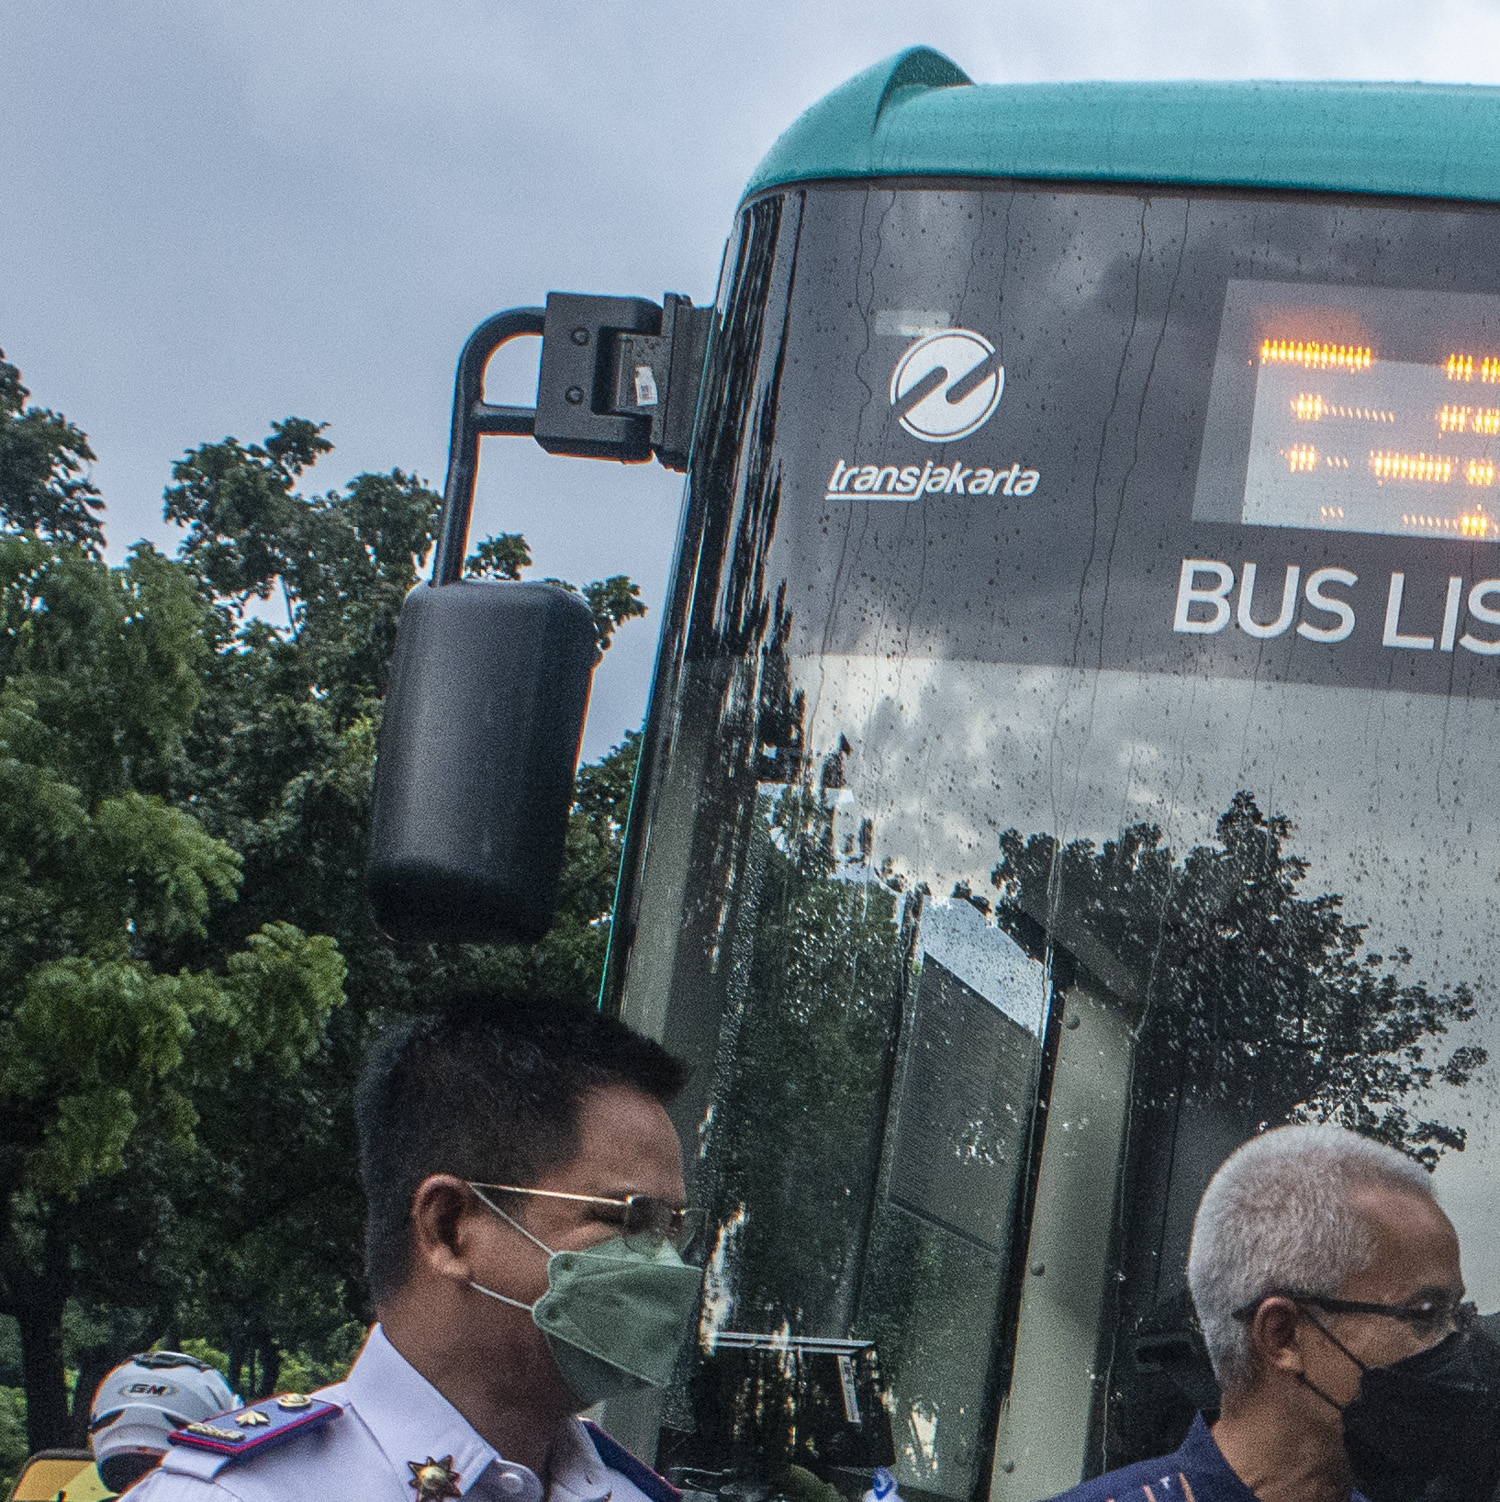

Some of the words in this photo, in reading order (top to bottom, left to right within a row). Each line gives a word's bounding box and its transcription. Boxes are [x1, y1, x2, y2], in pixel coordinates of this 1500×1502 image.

[825, 459, 1040, 500] transjakarta
[1173, 558, 1358, 643] BUS
[128, 1383, 167, 1396] GM
